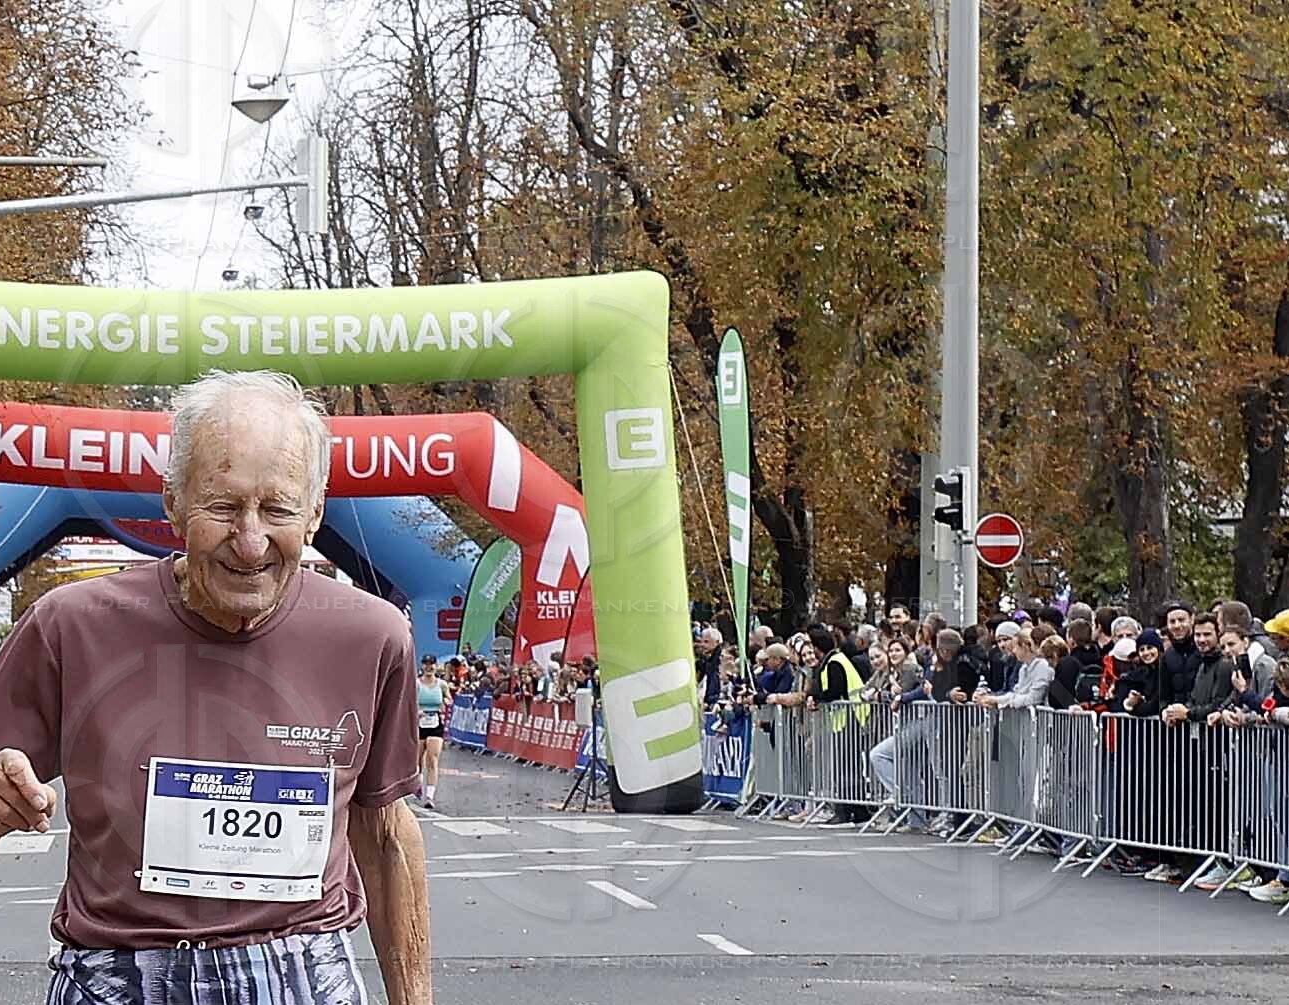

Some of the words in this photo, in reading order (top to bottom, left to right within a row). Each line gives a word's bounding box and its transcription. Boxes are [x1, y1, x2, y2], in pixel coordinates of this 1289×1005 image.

[199, 309, 513, 356] STEIERMARK
[537, 590, 578, 605] KLEI
[291, 727, 331, 740] GRAZ
[281, 740, 320, 748] MARATHON
[192, 773, 224, 784] GRAZ
[189, 784, 253, 796] MARATHON
[202, 807, 283, 839] 1820
